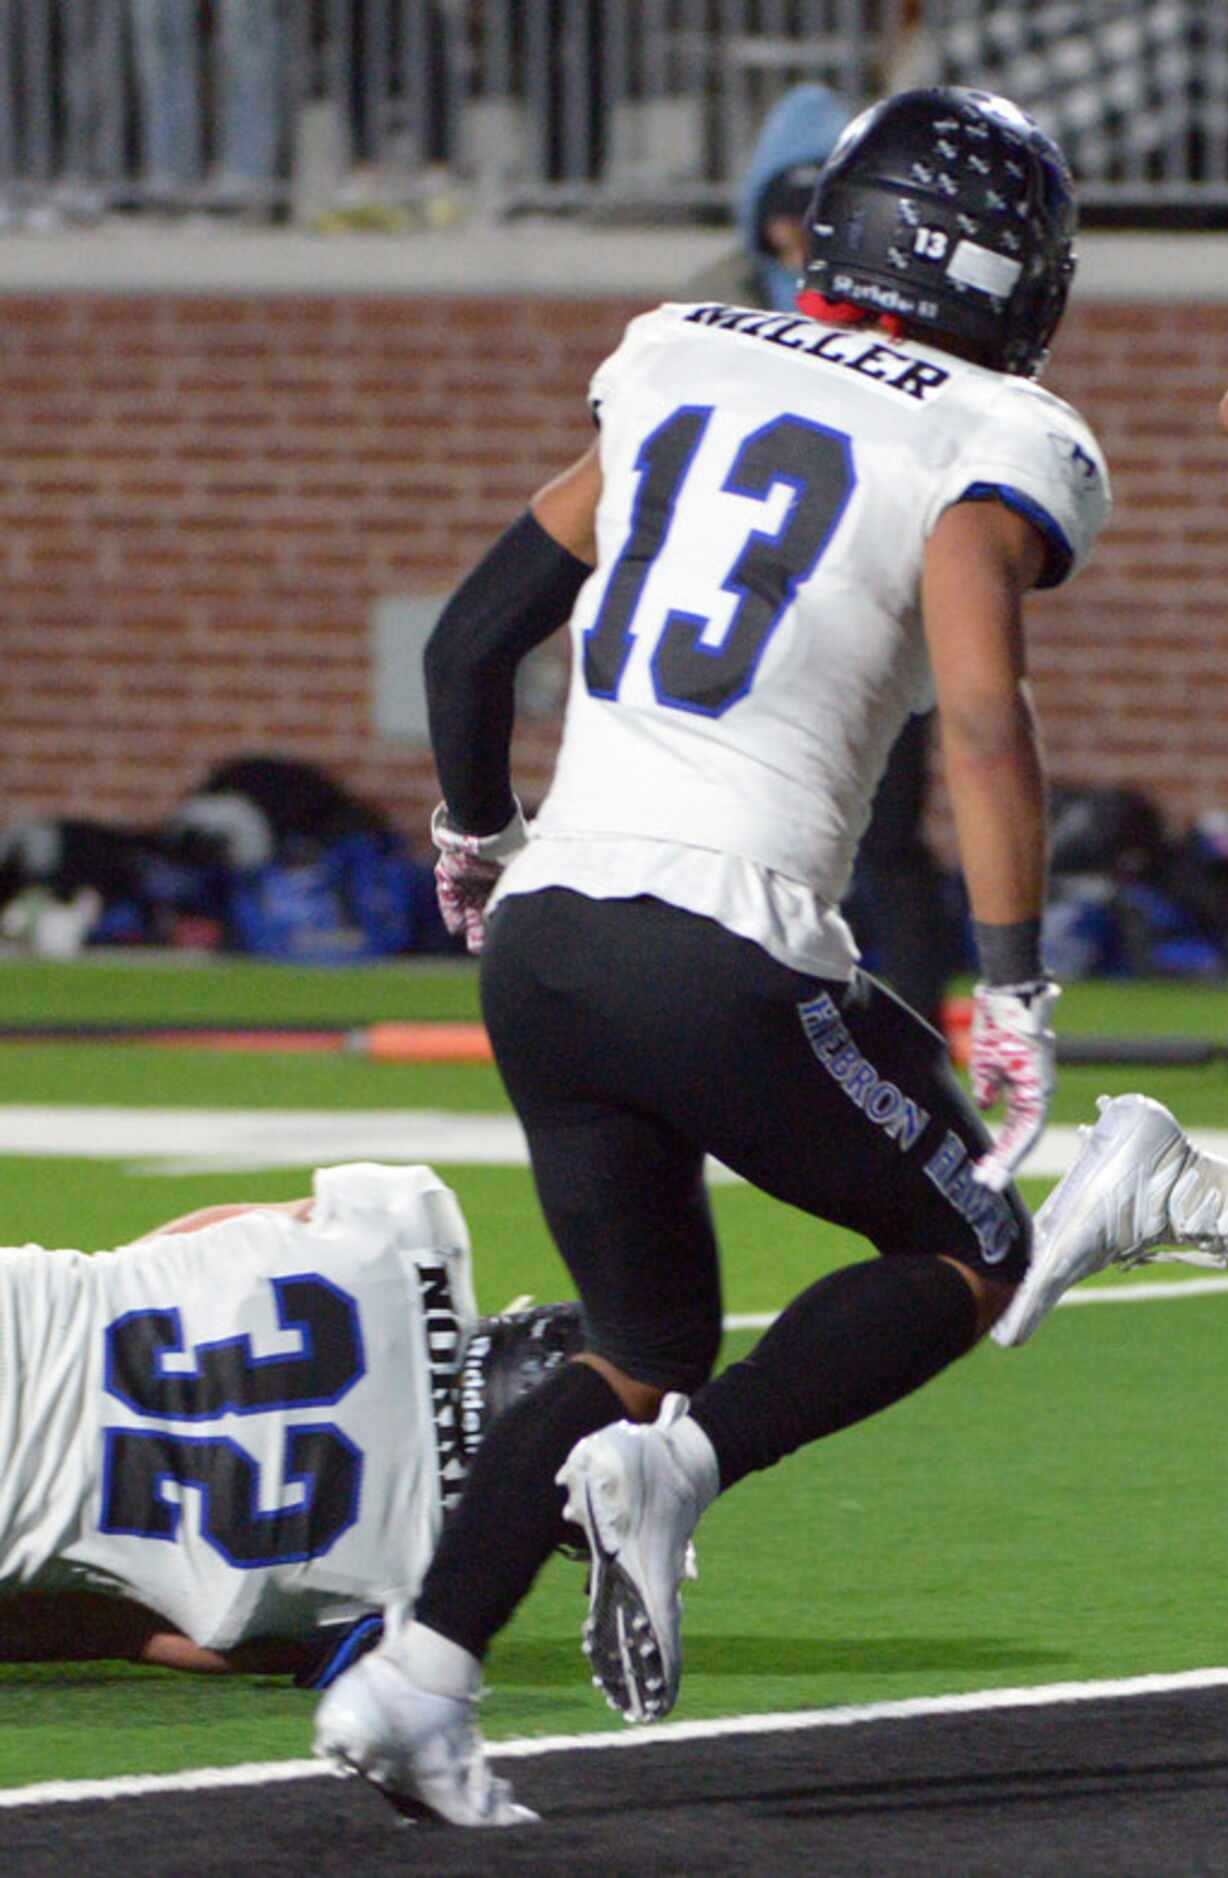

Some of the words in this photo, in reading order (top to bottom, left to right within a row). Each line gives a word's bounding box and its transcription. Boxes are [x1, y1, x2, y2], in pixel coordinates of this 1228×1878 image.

[914, 226, 949, 260] 13
[683, 305, 951, 400] MILLER
[583, 405, 858, 720] 13
[797, 992, 931, 1152] HEBRON
[99, 1272, 367, 1571] 32
